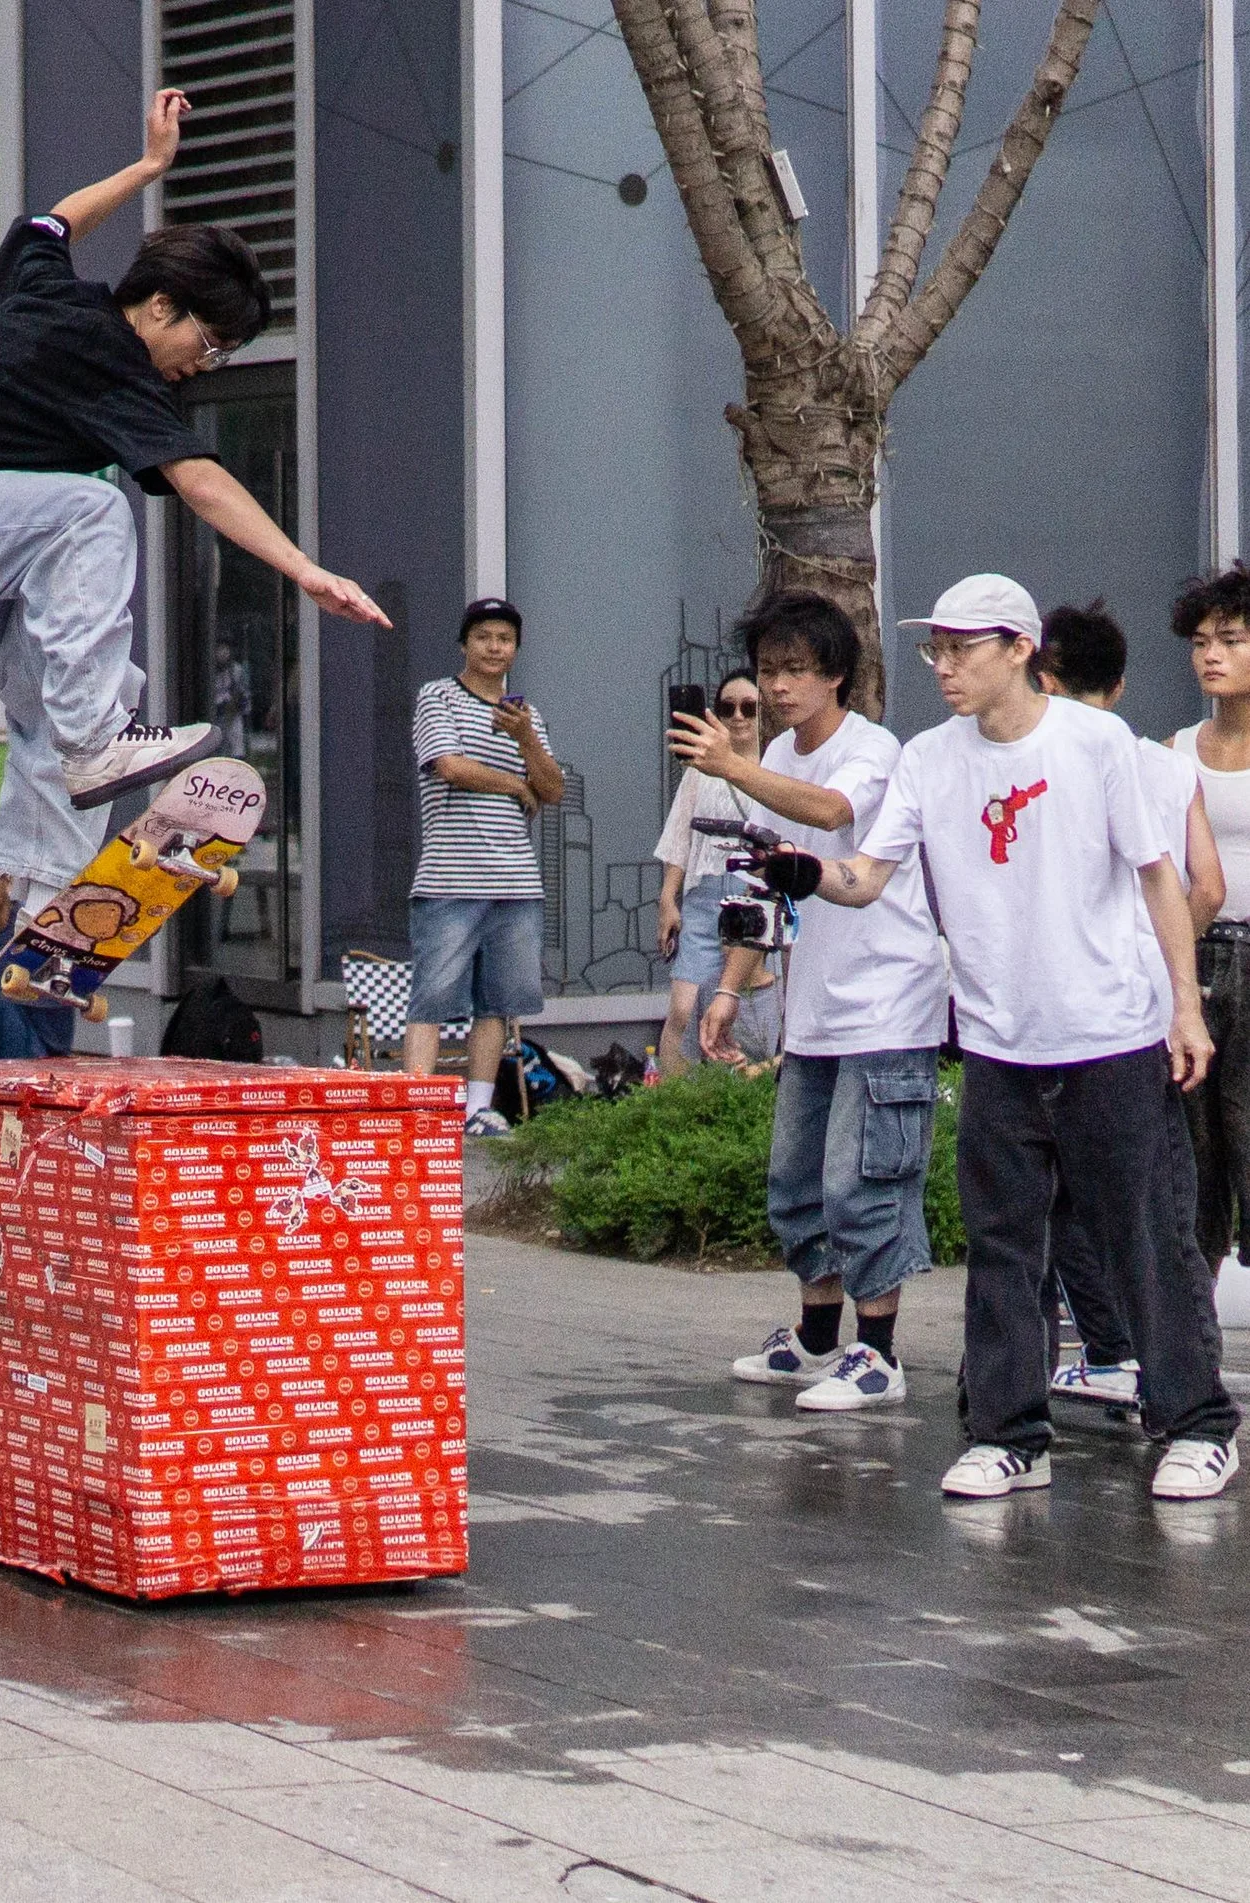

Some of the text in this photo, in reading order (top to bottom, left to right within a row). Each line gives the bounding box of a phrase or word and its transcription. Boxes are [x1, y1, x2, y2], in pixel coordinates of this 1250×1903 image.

[183, 776, 260, 815] Sheep
[242, 1091, 286, 1100] GOLUCK
[326, 1089, 369, 1097] GOLUCK
[409, 1087, 450, 1095] GOLUCK
[193, 1121, 237, 1130] GOLUCK
[277, 1120, 320, 1129] GOLUCK
[332, 1140, 375, 1150] GOLUCK
[414, 1138, 455, 1147] GOLUCK
[164, 1147, 209, 1156] GOLUCK
[249, 1145, 284, 1153] GOLUC
[346, 1161, 390, 1169] GOLUCK
[428, 1160, 462, 1168] GOLUC
[179, 1165, 223, 1174] GOLUCK
[171, 1190, 216, 1201] GOLUCK
[356, 1205, 391, 1214] OLUCK
[430, 1205, 463, 1213] GOLUC
[182, 1214, 225, 1223] GOLUCK
[278, 1234, 322, 1245] GOLUCK
[361, 1230, 404, 1240] GOLUCK
[193, 1239, 237, 1249] GOLUCK
[289, 1259, 332, 1270] GOLUCK
[372, 1255, 414, 1265] GOLUCK
[128, 1267, 165, 1276] GOLUCK
[205, 1264, 249, 1274] GOLUCK
[302, 1284, 346, 1294] GOLUCK
[386, 1280, 429, 1289] GOLUCK
[135, 1294, 178, 1303] GOLUCK
[218, 1289, 262, 1299] GOLUCK
[319, 1307, 362, 1317] GOLUCK
[402, 1302, 444, 1312] GOLUCK
[151, 1317, 195, 1327] GOLUCK
[235, 1312, 279, 1322] GOLUCK
[334, 1332, 377, 1341] GOLUCK
[417, 1327, 458, 1337] GOLUCK
[251, 1336, 294, 1346] GOLUCK
[166, 1342, 210, 1352] GOLUCK
[350, 1352, 394, 1362] GOLUCK
[433, 1349, 465, 1357] GOLUC
[267, 1357, 310, 1368] GOLUCK
[182, 1363, 226, 1374] GOLUCK
[282, 1380, 325, 1390] GOLUCK
[365, 1376, 408, 1385] GOLUCK
[198, 1386, 241, 1397] GOLUCK
[295, 1402, 339, 1411] GOLUCK
[378, 1398, 421, 1407] GOLUCK
[211, 1407, 255, 1417] GOLUCK
[131, 1414, 170, 1424] GOLUCK
[392, 1420, 435, 1431] GOLUCK
[309, 1427, 352, 1438] GOLUCK
[225, 1434, 269, 1445] GOLUCK
[139, 1441, 184, 1451] GOLUCK
[360, 1446, 403, 1457] GOLUCK
[277, 1454, 320, 1465] GOLUCK
[193, 1462, 237, 1473] GOLUCK
[370, 1472, 413, 1483] GOLUCK
[287, 1479, 331, 1490] GOLUCK
[203, 1486, 248, 1497] GOLUCK
[379, 1494, 420, 1504] GOLUCK
[380, 1514, 422, 1524] GOLUCK
[214, 1528, 257, 1539] GOLUCK
[384, 1534, 426, 1545] GOLUCK
[304, 1554, 347, 1564] GOLUCK
[386, 1551, 428, 1559] GOLUCK
[221, 1561, 263, 1573] GOLUCK
[137, 1573, 180, 1585] GOLUCK
